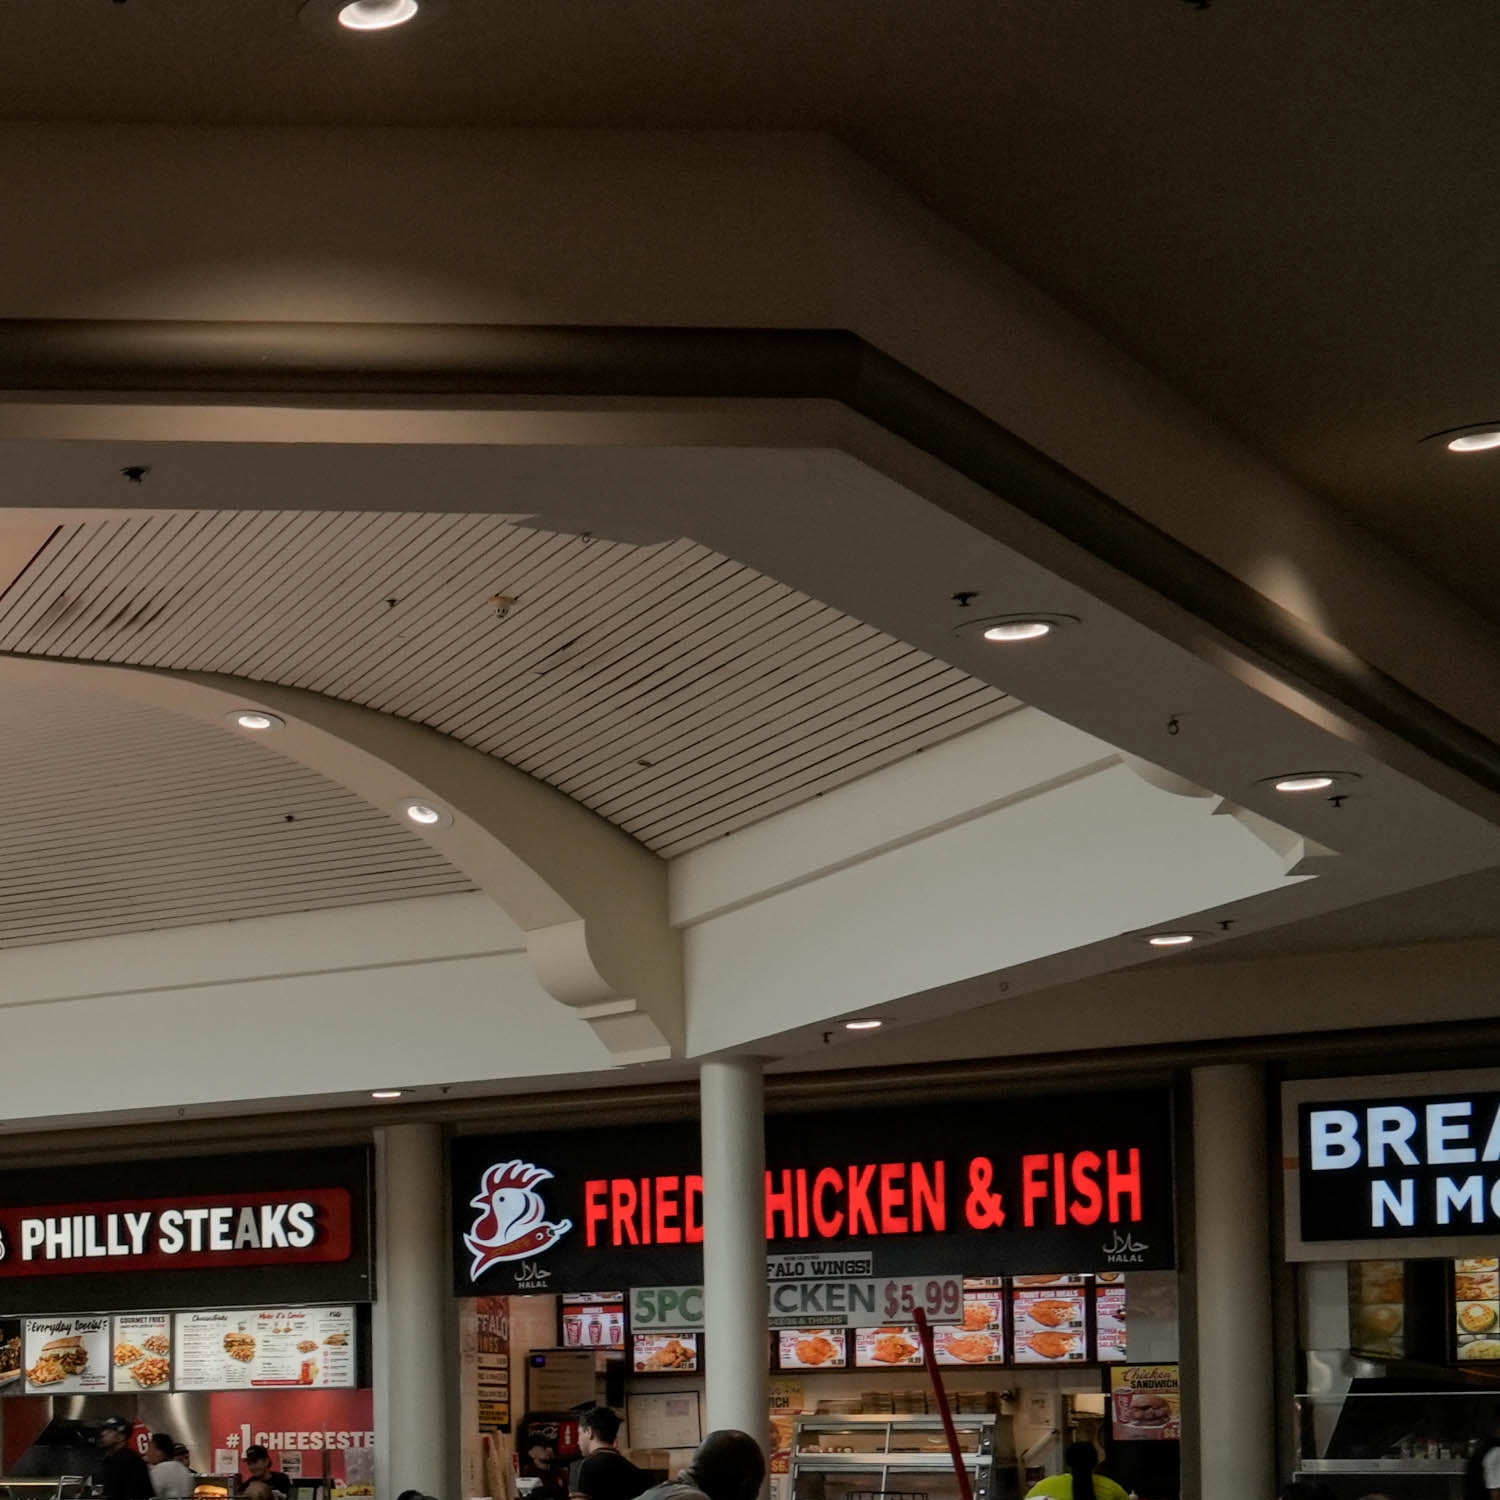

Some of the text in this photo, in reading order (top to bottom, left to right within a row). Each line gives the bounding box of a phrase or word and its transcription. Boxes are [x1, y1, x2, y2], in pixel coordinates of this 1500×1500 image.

[585, 1147, 1142, 1248] FRIED HICKEN & FISH
[1371, 1178, 1415, 1228] N
[21, 1201, 317, 1262] PHILLY STEAKS
[1101, 1229, 1150, 1254] حلال
[767, 1260, 871, 1278] FALO WINGS!
[1107, 1254, 1145, 1263] HALAL
[513, 1260, 552, 1282] حلال
[517, 1280, 550, 1289] HALAL
[633, 1279, 959, 1324] 5PC CKEN $599
[31, 1318, 103, 1336] Everyday Special
[1120, 1366, 1172, 1382] Chicken
[1131, 1379, 1178, 1389] SANDWICH
[226, 1423, 375, 1459] #1 CHEESESTE
